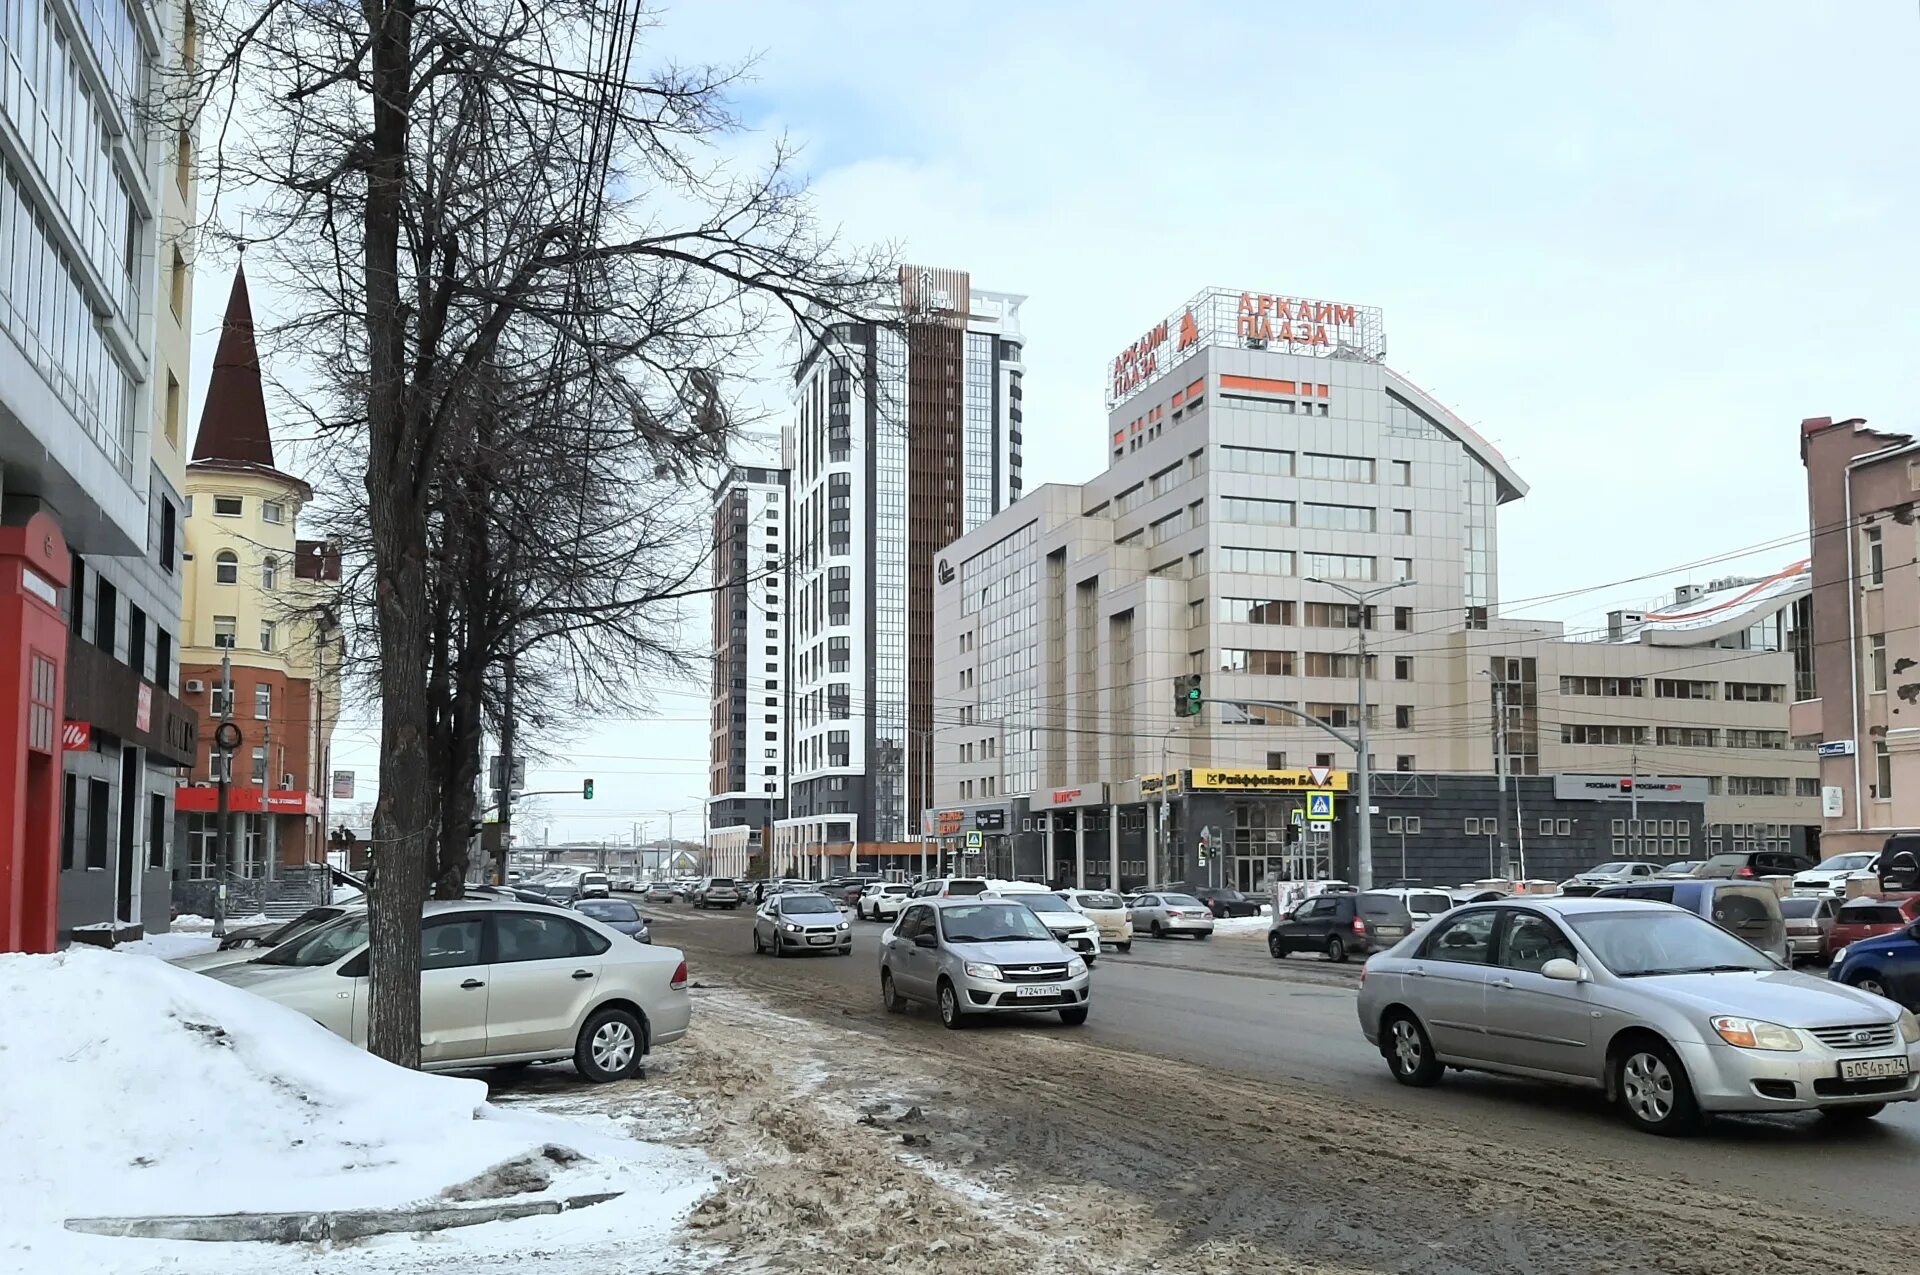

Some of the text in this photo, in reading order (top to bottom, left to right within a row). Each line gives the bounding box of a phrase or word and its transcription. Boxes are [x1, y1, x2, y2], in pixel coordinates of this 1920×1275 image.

[1238, 292, 1356, 327] АРКАИМ
[1237, 315, 1329, 347] ПЛАЗА
[1114, 319, 1168, 378] АРКАИМ
[1114, 352, 1158, 400] ПЛАЗА
[1218, 773, 1333, 787] Райффайзен БАК
[938, 823, 961, 835] ЦЕНТР
